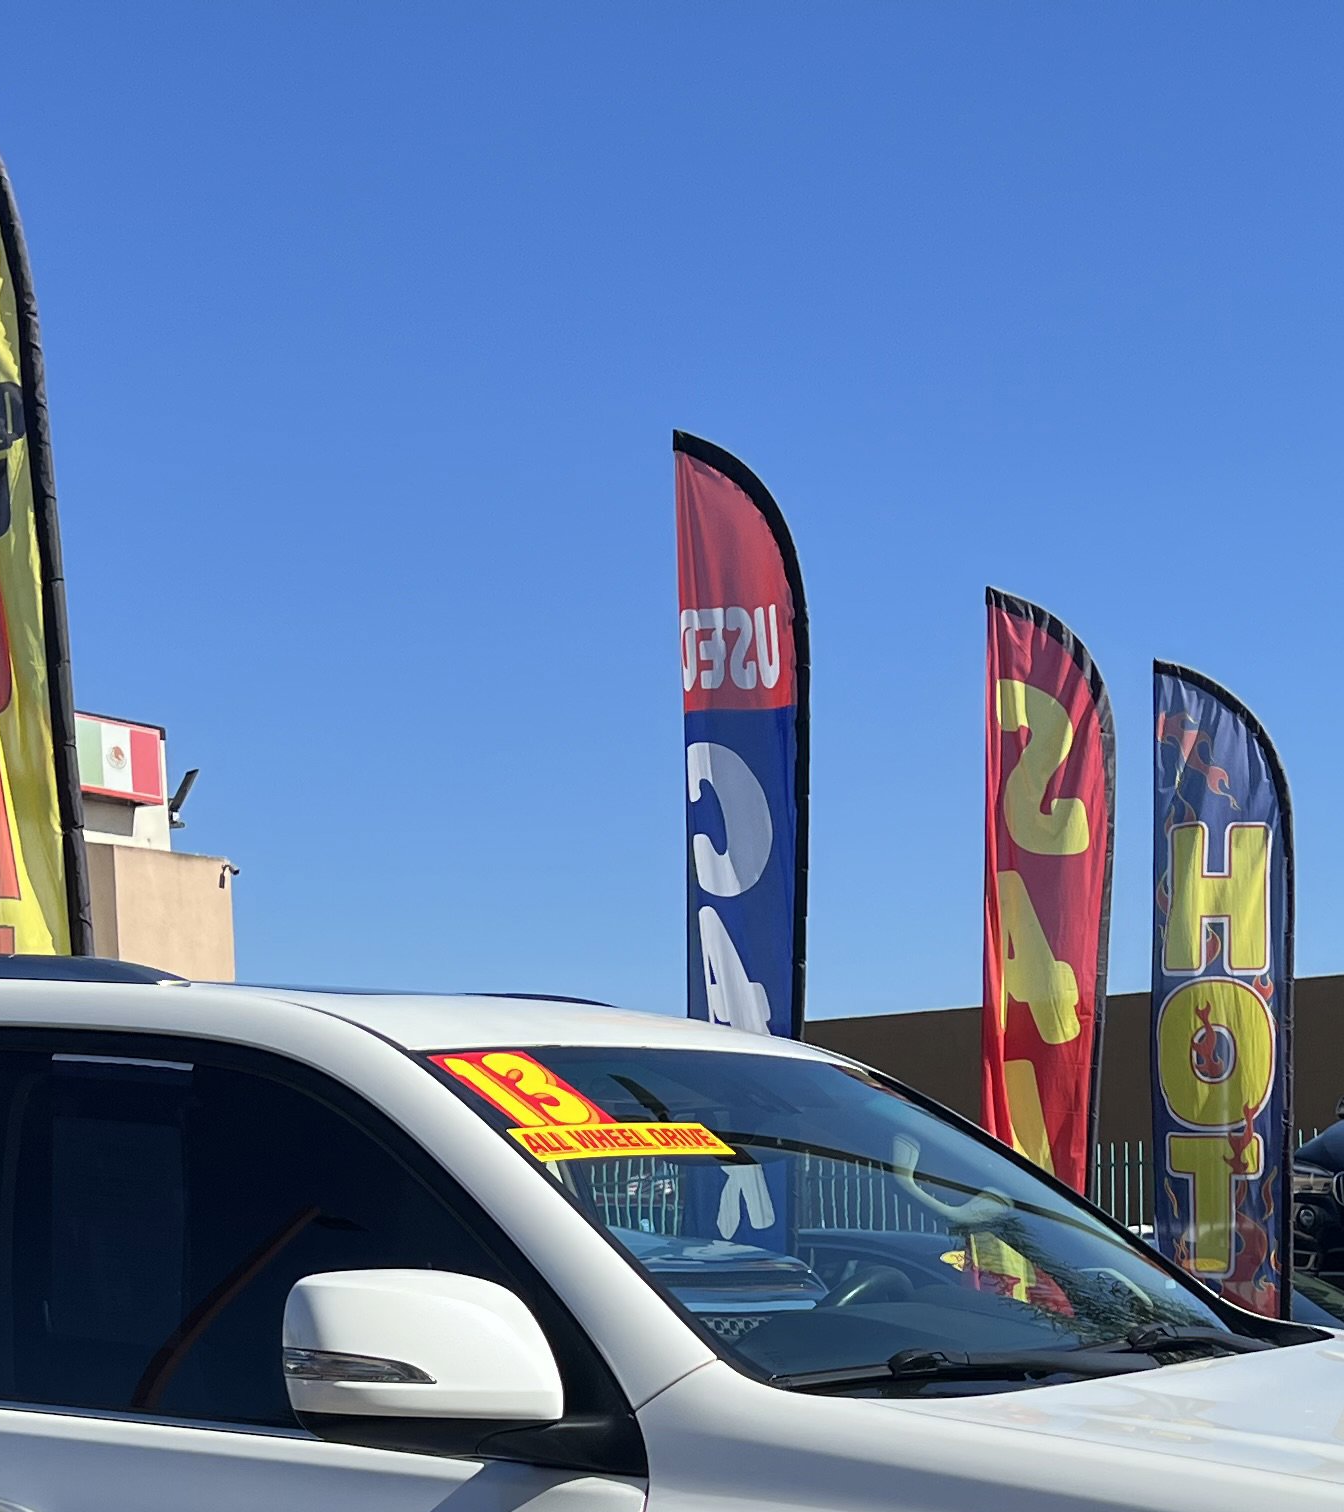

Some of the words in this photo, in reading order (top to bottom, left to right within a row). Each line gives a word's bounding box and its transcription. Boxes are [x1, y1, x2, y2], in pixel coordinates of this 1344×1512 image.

[1158, 821, 1276, 1280] HOT
[443, 1052, 600, 1127] 13
[522, 1132, 573, 1154] ALL
[570, 1128, 654, 1150] WHEEL
[650, 1127, 719, 1149] DRIVE
